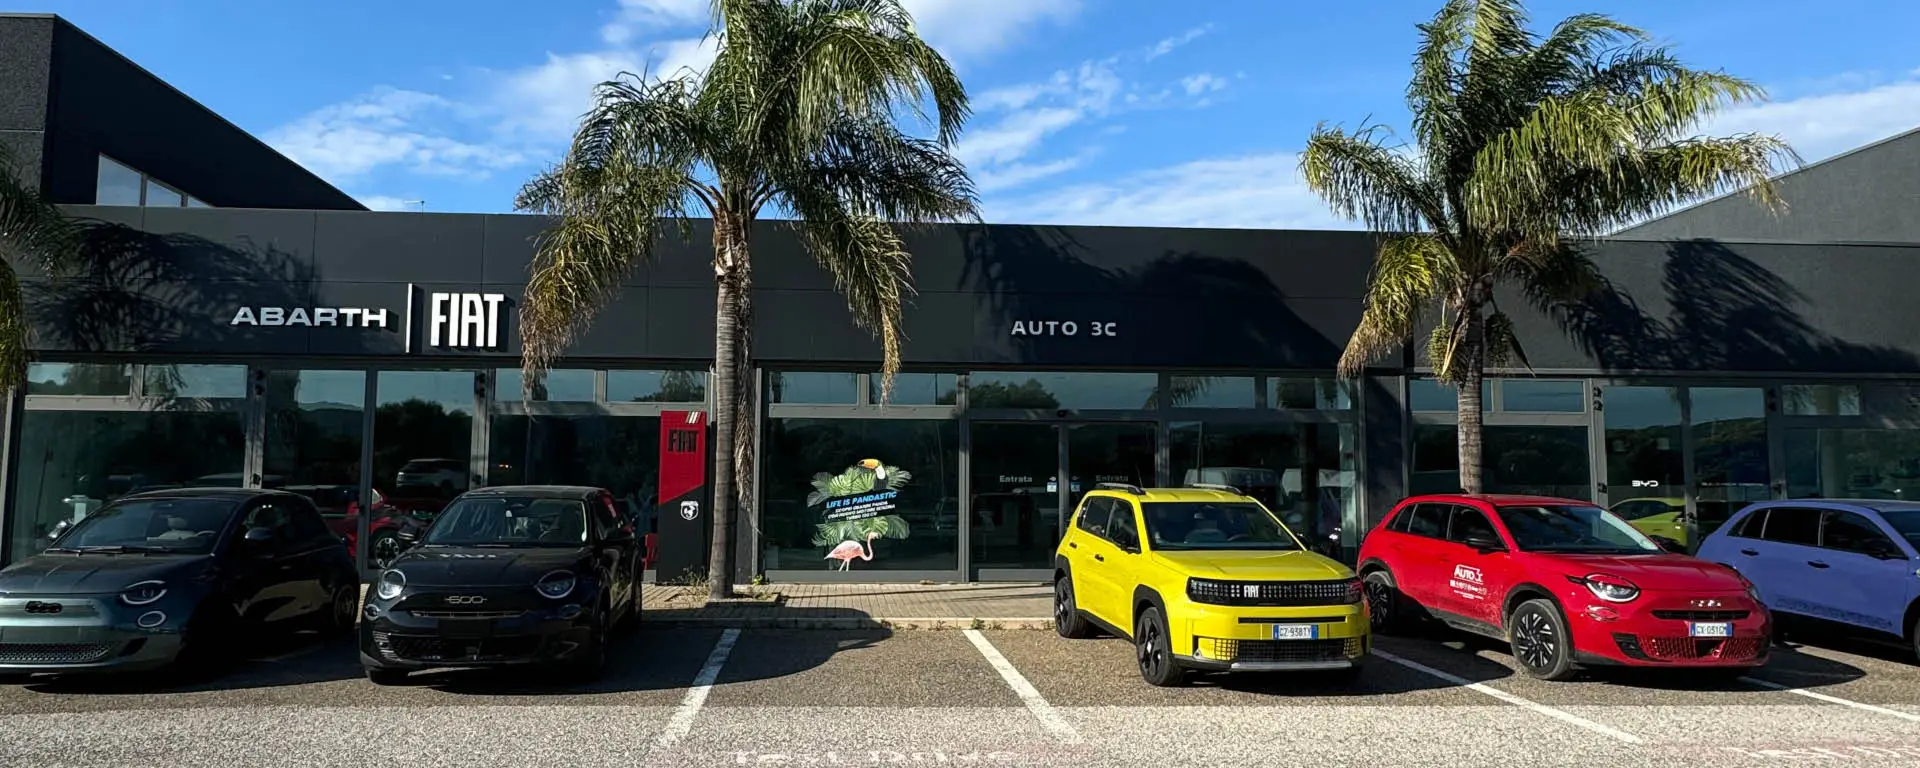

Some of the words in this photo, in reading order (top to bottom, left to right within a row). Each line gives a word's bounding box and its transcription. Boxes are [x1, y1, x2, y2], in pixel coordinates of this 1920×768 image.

[231, 306, 387, 327] ABARTH
[430, 292, 504, 347] FIAT
[1011, 320, 1078, 336] AUTO
[1091, 321, 1116, 336] 3C
[668, 429, 698, 452] FIAT
[826, 500, 841, 508] LIFE
[852, 491, 897, 504] PANDASTIC
[1244, 585, 1259, 598] FIAT
